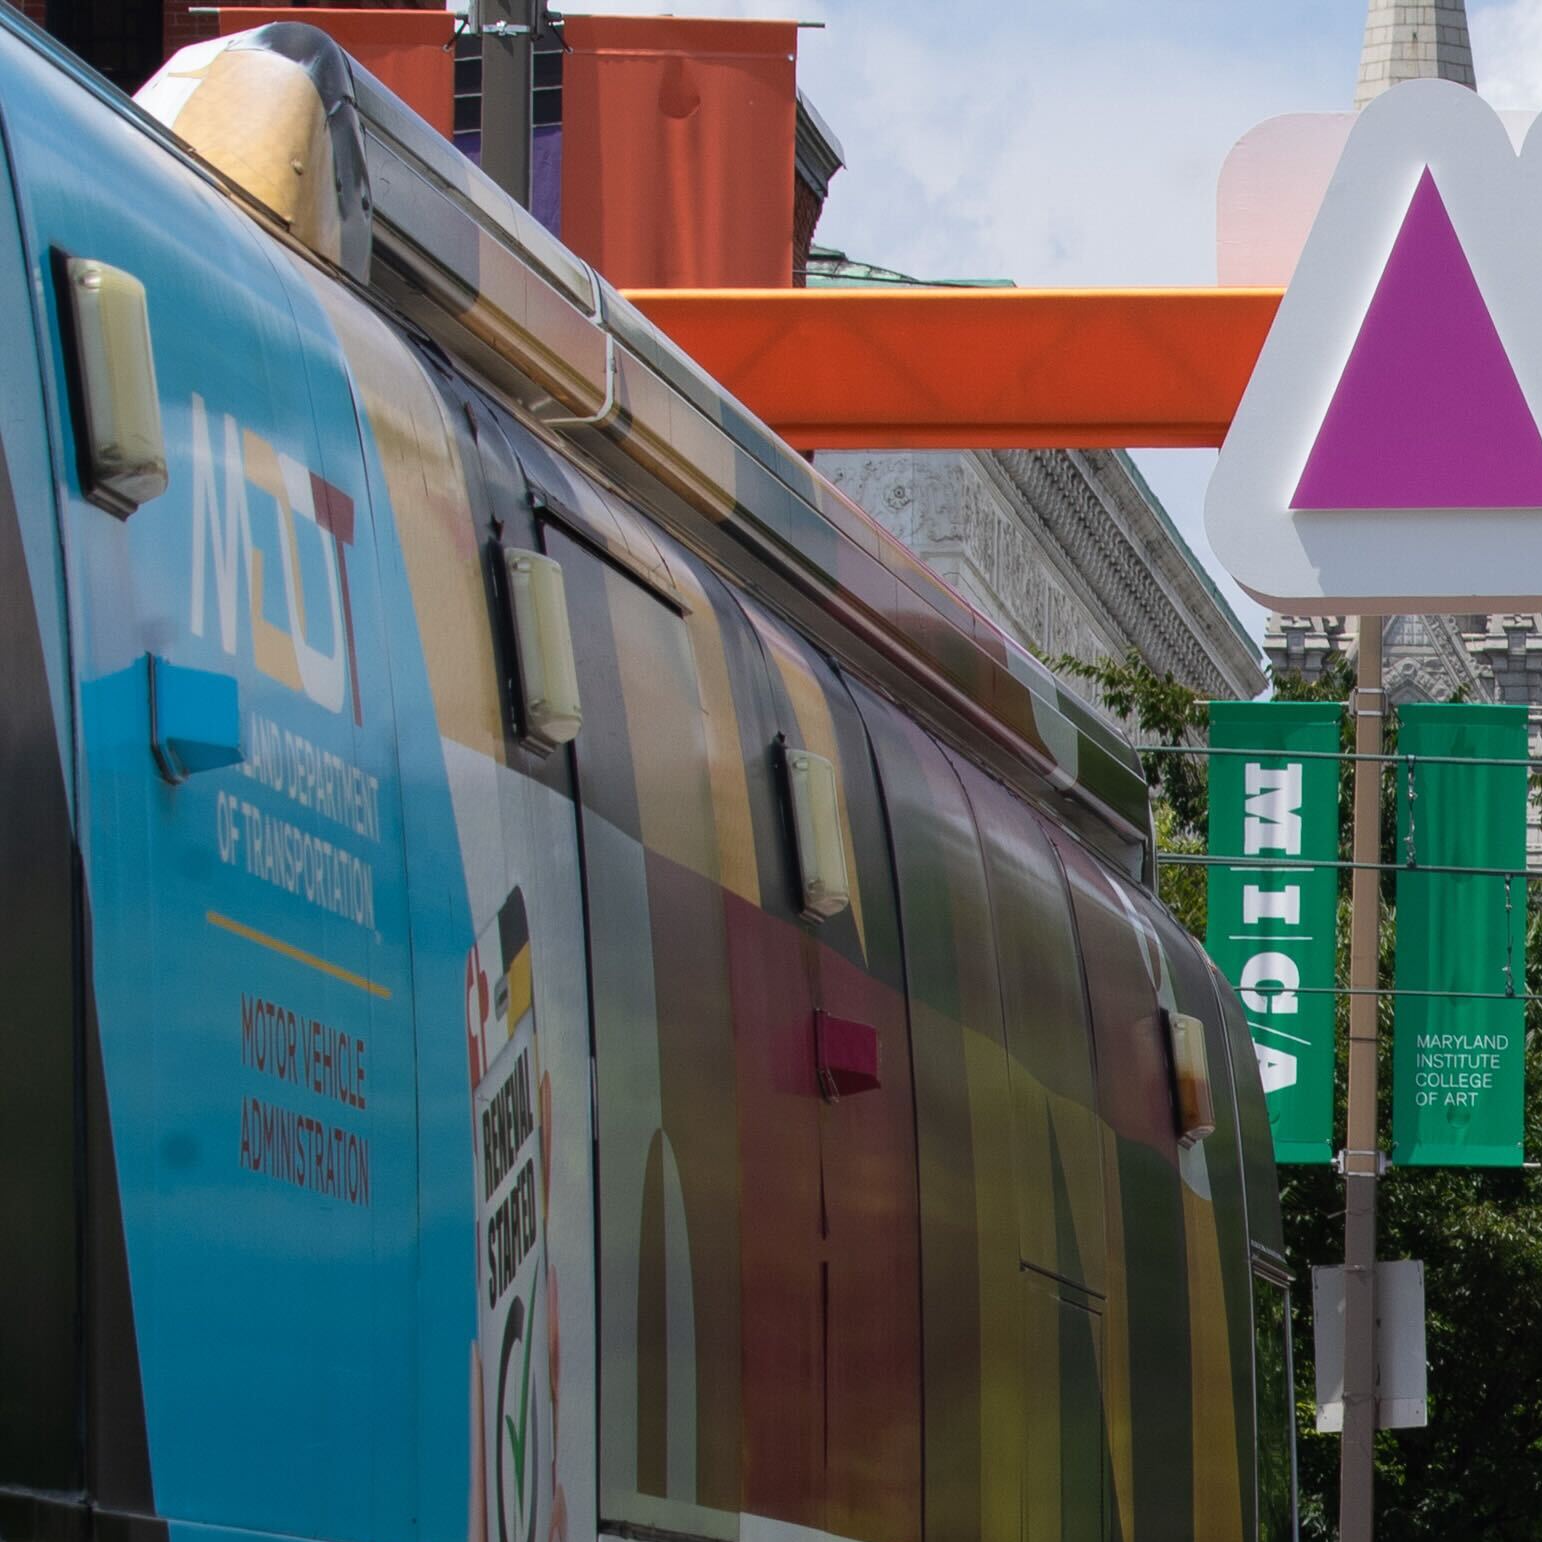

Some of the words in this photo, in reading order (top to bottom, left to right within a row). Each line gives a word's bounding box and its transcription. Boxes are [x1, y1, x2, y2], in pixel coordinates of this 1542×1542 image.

[284, 727, 380, 844] DEPARTMENT
[217, 789, 240, 867] OF
[240, 800, 376, 931] TRANSPORTATION
[1239, 762, 1303, 1094] MICA
[241, 990, 299, 1085] MOTOR
[300, 1015, 366, 1111] VEHICLE
[1415, 1072, 1494, 1089] COLLEGE
[1416, 1033, 1509, 1051] MARYLAND
[1416, 1052, 1501, 1069] INSTITUTE
[240, 1095, 370, 1208] ADMINISTRATION
[1415, 1091, 1439, 1106] OF
[1443, 1091, 1479, 1107] ART
